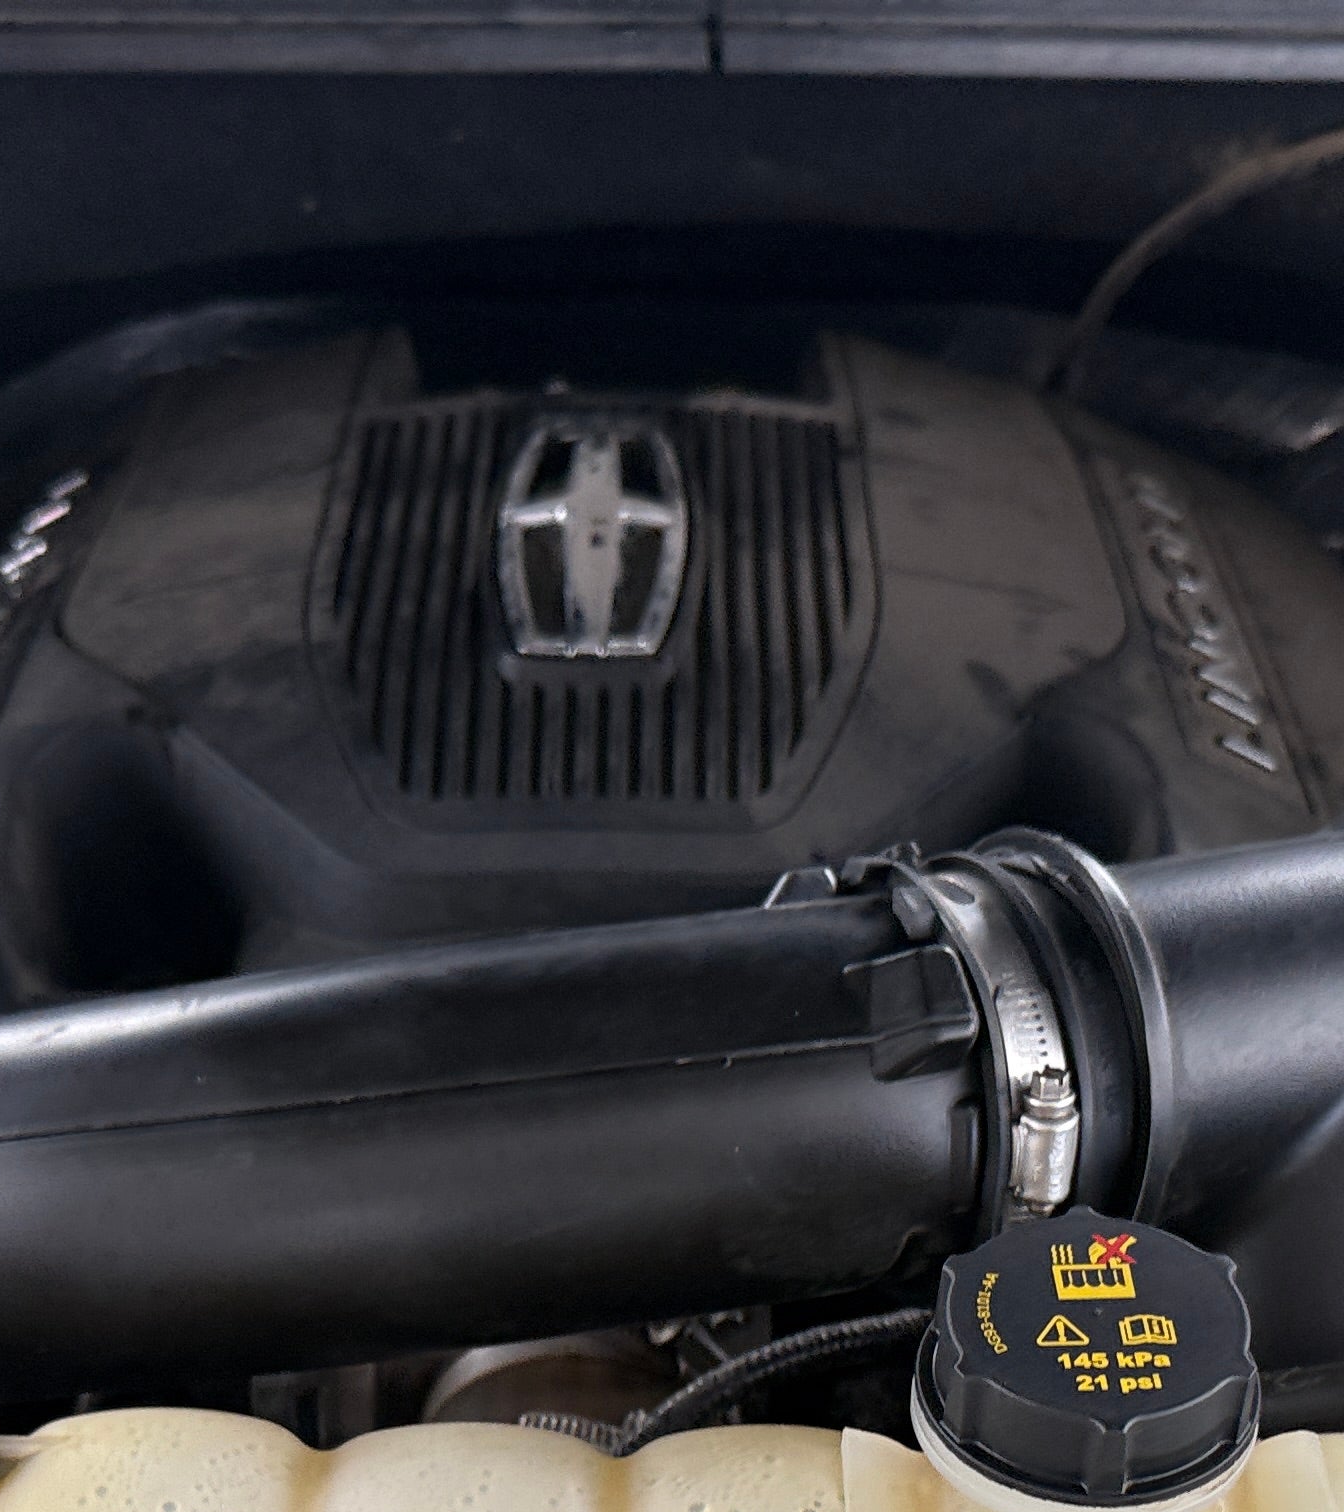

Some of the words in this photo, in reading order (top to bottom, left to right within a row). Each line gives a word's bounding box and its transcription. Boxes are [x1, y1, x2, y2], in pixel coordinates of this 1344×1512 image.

[1057, 1352, 1109, 1370] 145
[1116, 1351, 1171, 1369] kPa
[1076, 1374, 1109, 1392] 21
[1120, 1373, 1163, 1394] psi
